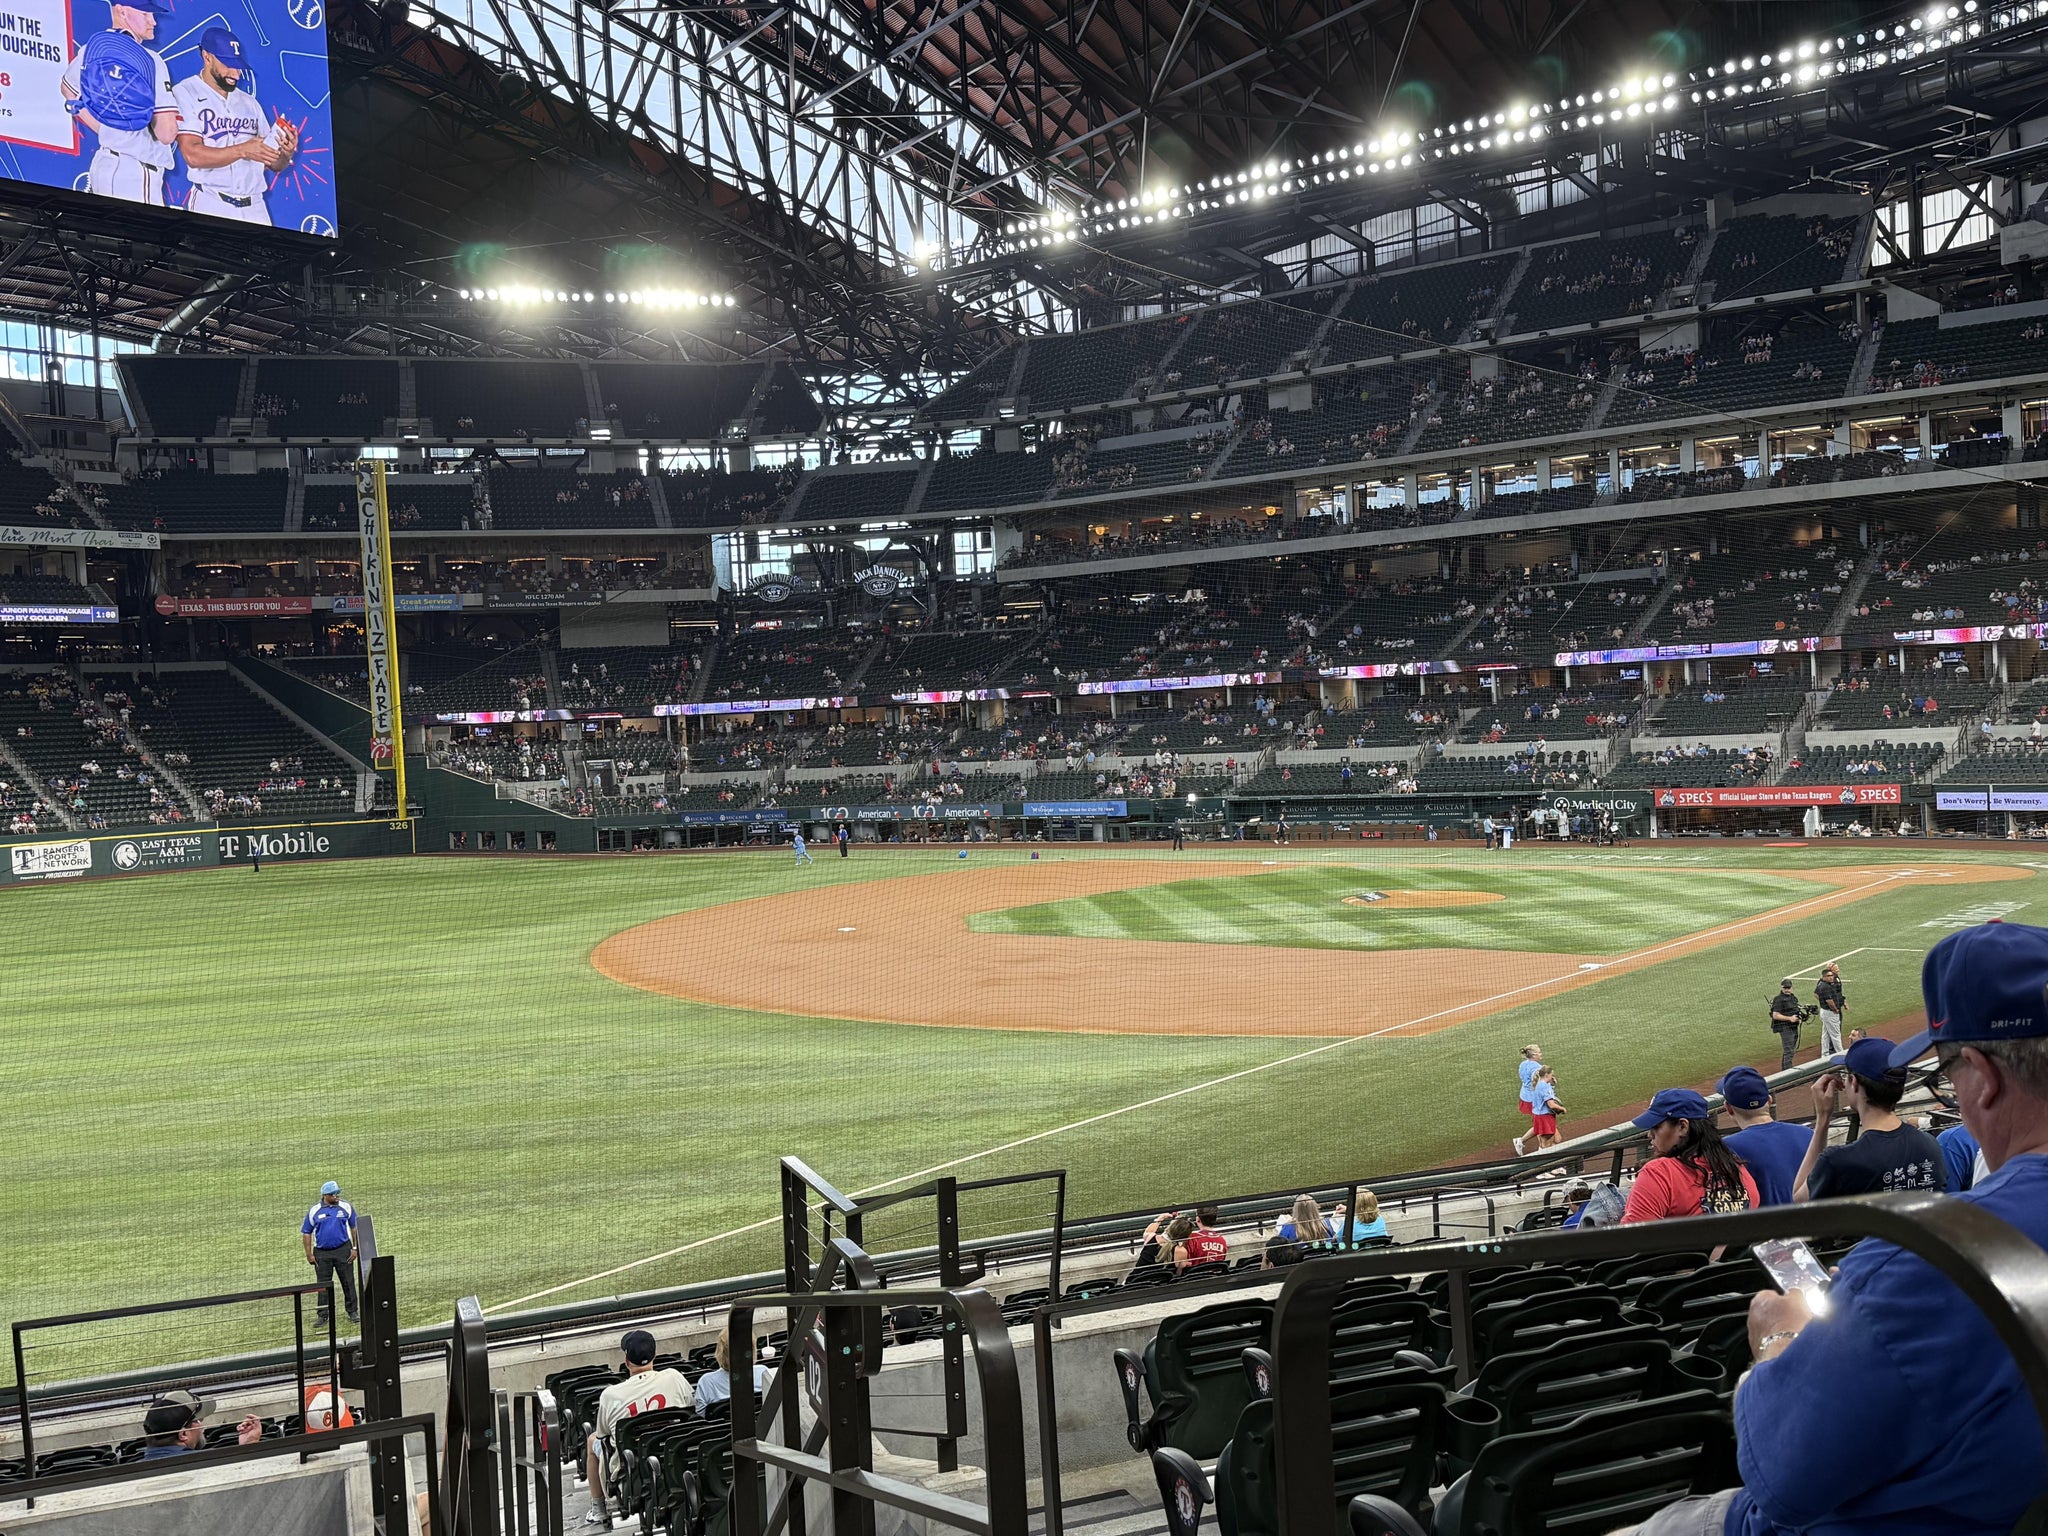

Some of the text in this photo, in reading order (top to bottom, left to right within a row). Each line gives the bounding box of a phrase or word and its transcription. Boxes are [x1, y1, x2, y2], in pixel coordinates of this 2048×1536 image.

[18, 16, 42, 38] THE
[0, 34, 61, 63] OUCHERS
[230, 41, 240, 55] T
[0, 108, 13, 117] rs
[29, 530, 77, 544] Mint
[82, 531, 114, 546] Thai
[853, 564, 905, 584] JACK DANIEL'S
[748, 575, 767, 590] JACK
[180, 602, 281, 613] TEXAS, THIS BUD'S FOR YOU
[374, 658, 387, 729] FARE
[1679, 792, 1713, 803] SPEC'S
[1719, 793, 1740, 801] Official
[1743, 793, 1758, 802] Liquor
[1759, 792, 1773, 800] Store
[1774, 792, 1781, 800] of
[1782, 792, 1791, 800] the
[1809, 791, 1832, 800] Rangers
[1860, 786, 1897, 800] SPEC'S
[1571, 800, 1637, 812] Medical City
[857, 810, 891, 819] American
[945, 808, 980, 817] American
[389, 822, 408, 830] 326
[141, 837, 201, 849] EAST TEXAS
[246, 831, 330, 857] Mobile
[43, 845, 84, 855] RANGERS
[159, 847, 185, 857] A&M
[15, 848, 34, 871] T
[43, 852, 77, 861] SPORTS
[141, 855, 202, 866] UNIVERSITY
[44, 858, 89, 869] NETWORK
[1991, 1018, 2032, 1029] DRI-FIT
[809, 1354, 822, 1405] 02
